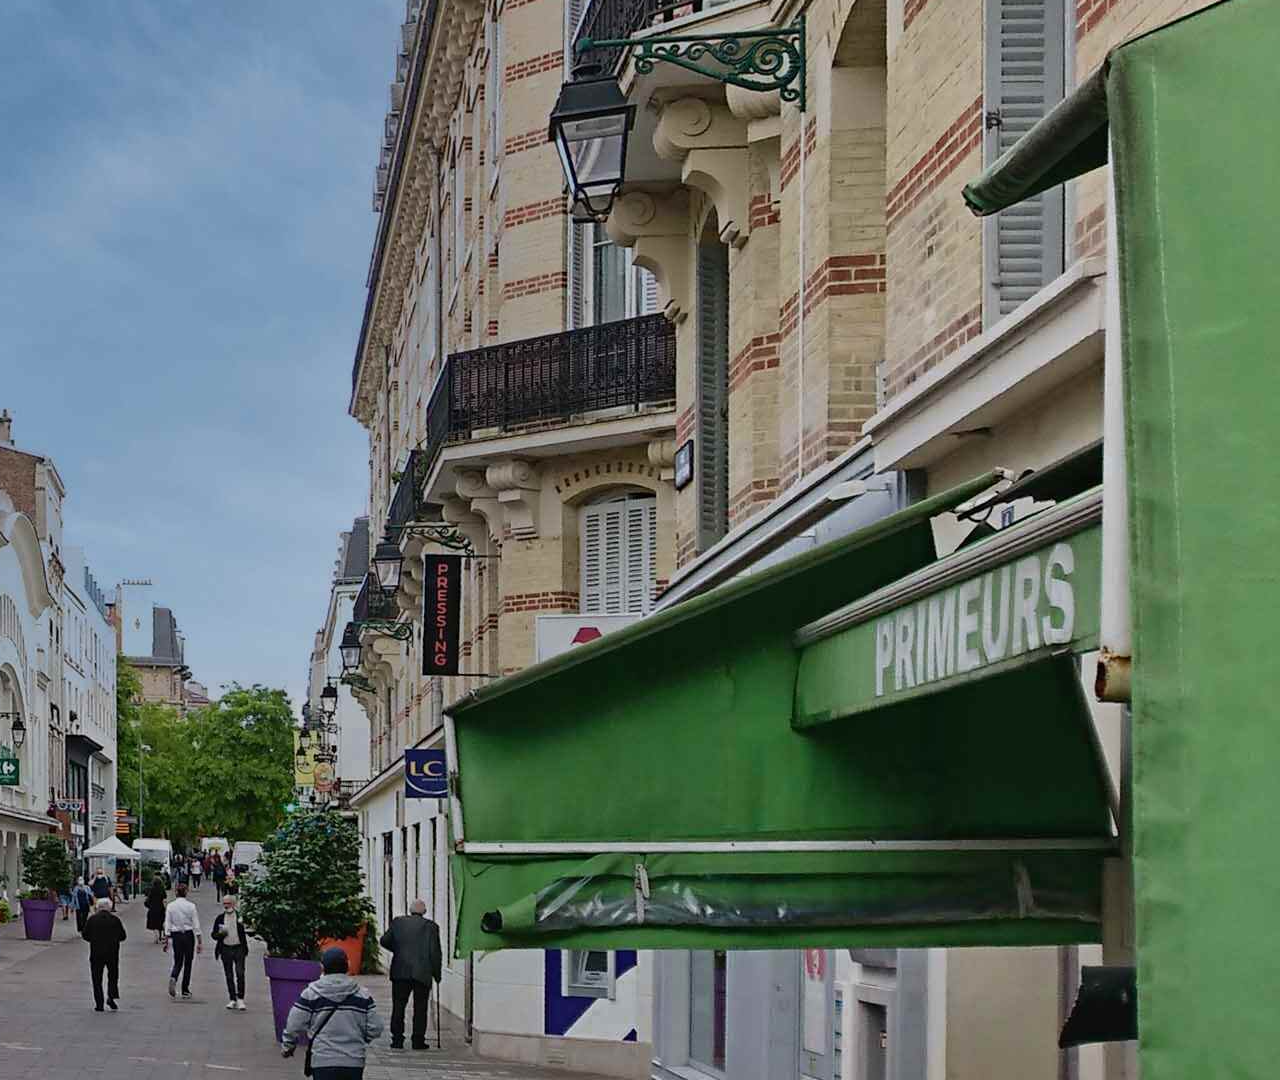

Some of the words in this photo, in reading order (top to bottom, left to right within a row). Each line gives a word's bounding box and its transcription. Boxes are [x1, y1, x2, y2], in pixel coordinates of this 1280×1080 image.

[435, 563, 449, 666] PRESSING
[875, 542, 1075, 697] PRIMEURS
[410, 760, 443, 777] LC
